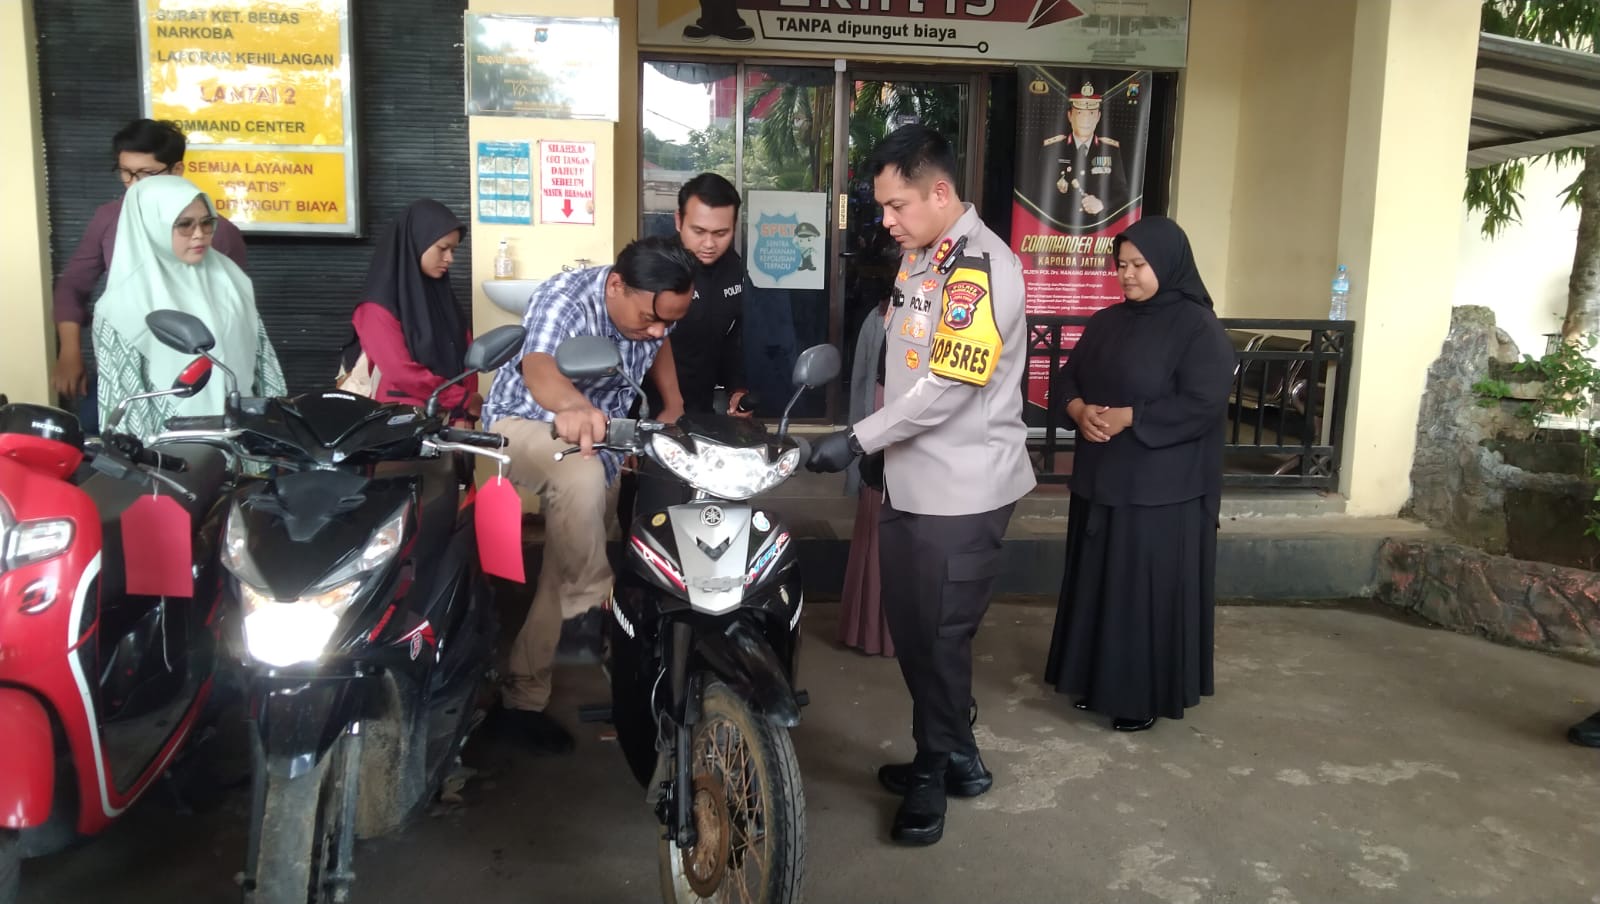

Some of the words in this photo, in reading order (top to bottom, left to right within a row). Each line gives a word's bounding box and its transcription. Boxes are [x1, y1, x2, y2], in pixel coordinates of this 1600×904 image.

[211, 11, 244, 24] KET.
[248, 12, 300, 25] BEBAS
[156, 26, 234, 39] NARKOBA
[776, 17, 832, 33] TANPA
[837, 20, 909, 40] dipungut
[914, 24, 957, 42] biaya
[157, 51, 232, 64] LAPORAN
[236, 53, 335, 66] KEHILANGAN
[201, 87, 278, 104] LANTAI
[284, 88, 297, 104] 2
[166, 119, 241, 132] OMMAND
[245, 120, 305, 133] CENTER
[188, 162, 242, 174] SEMUA
[245, 162, 314, 175] LAYANAN
[296, 201, 338, 213] BIAYA
[1020, 235, 1094, 254] COMMANDER
[1038, 256, 1077, 267] KAPOLDA
[1080, 257, 1105, 267] JATIM
[723, 284, 742, 298] POLRI
[910, 296, 932, 313] POLRI
